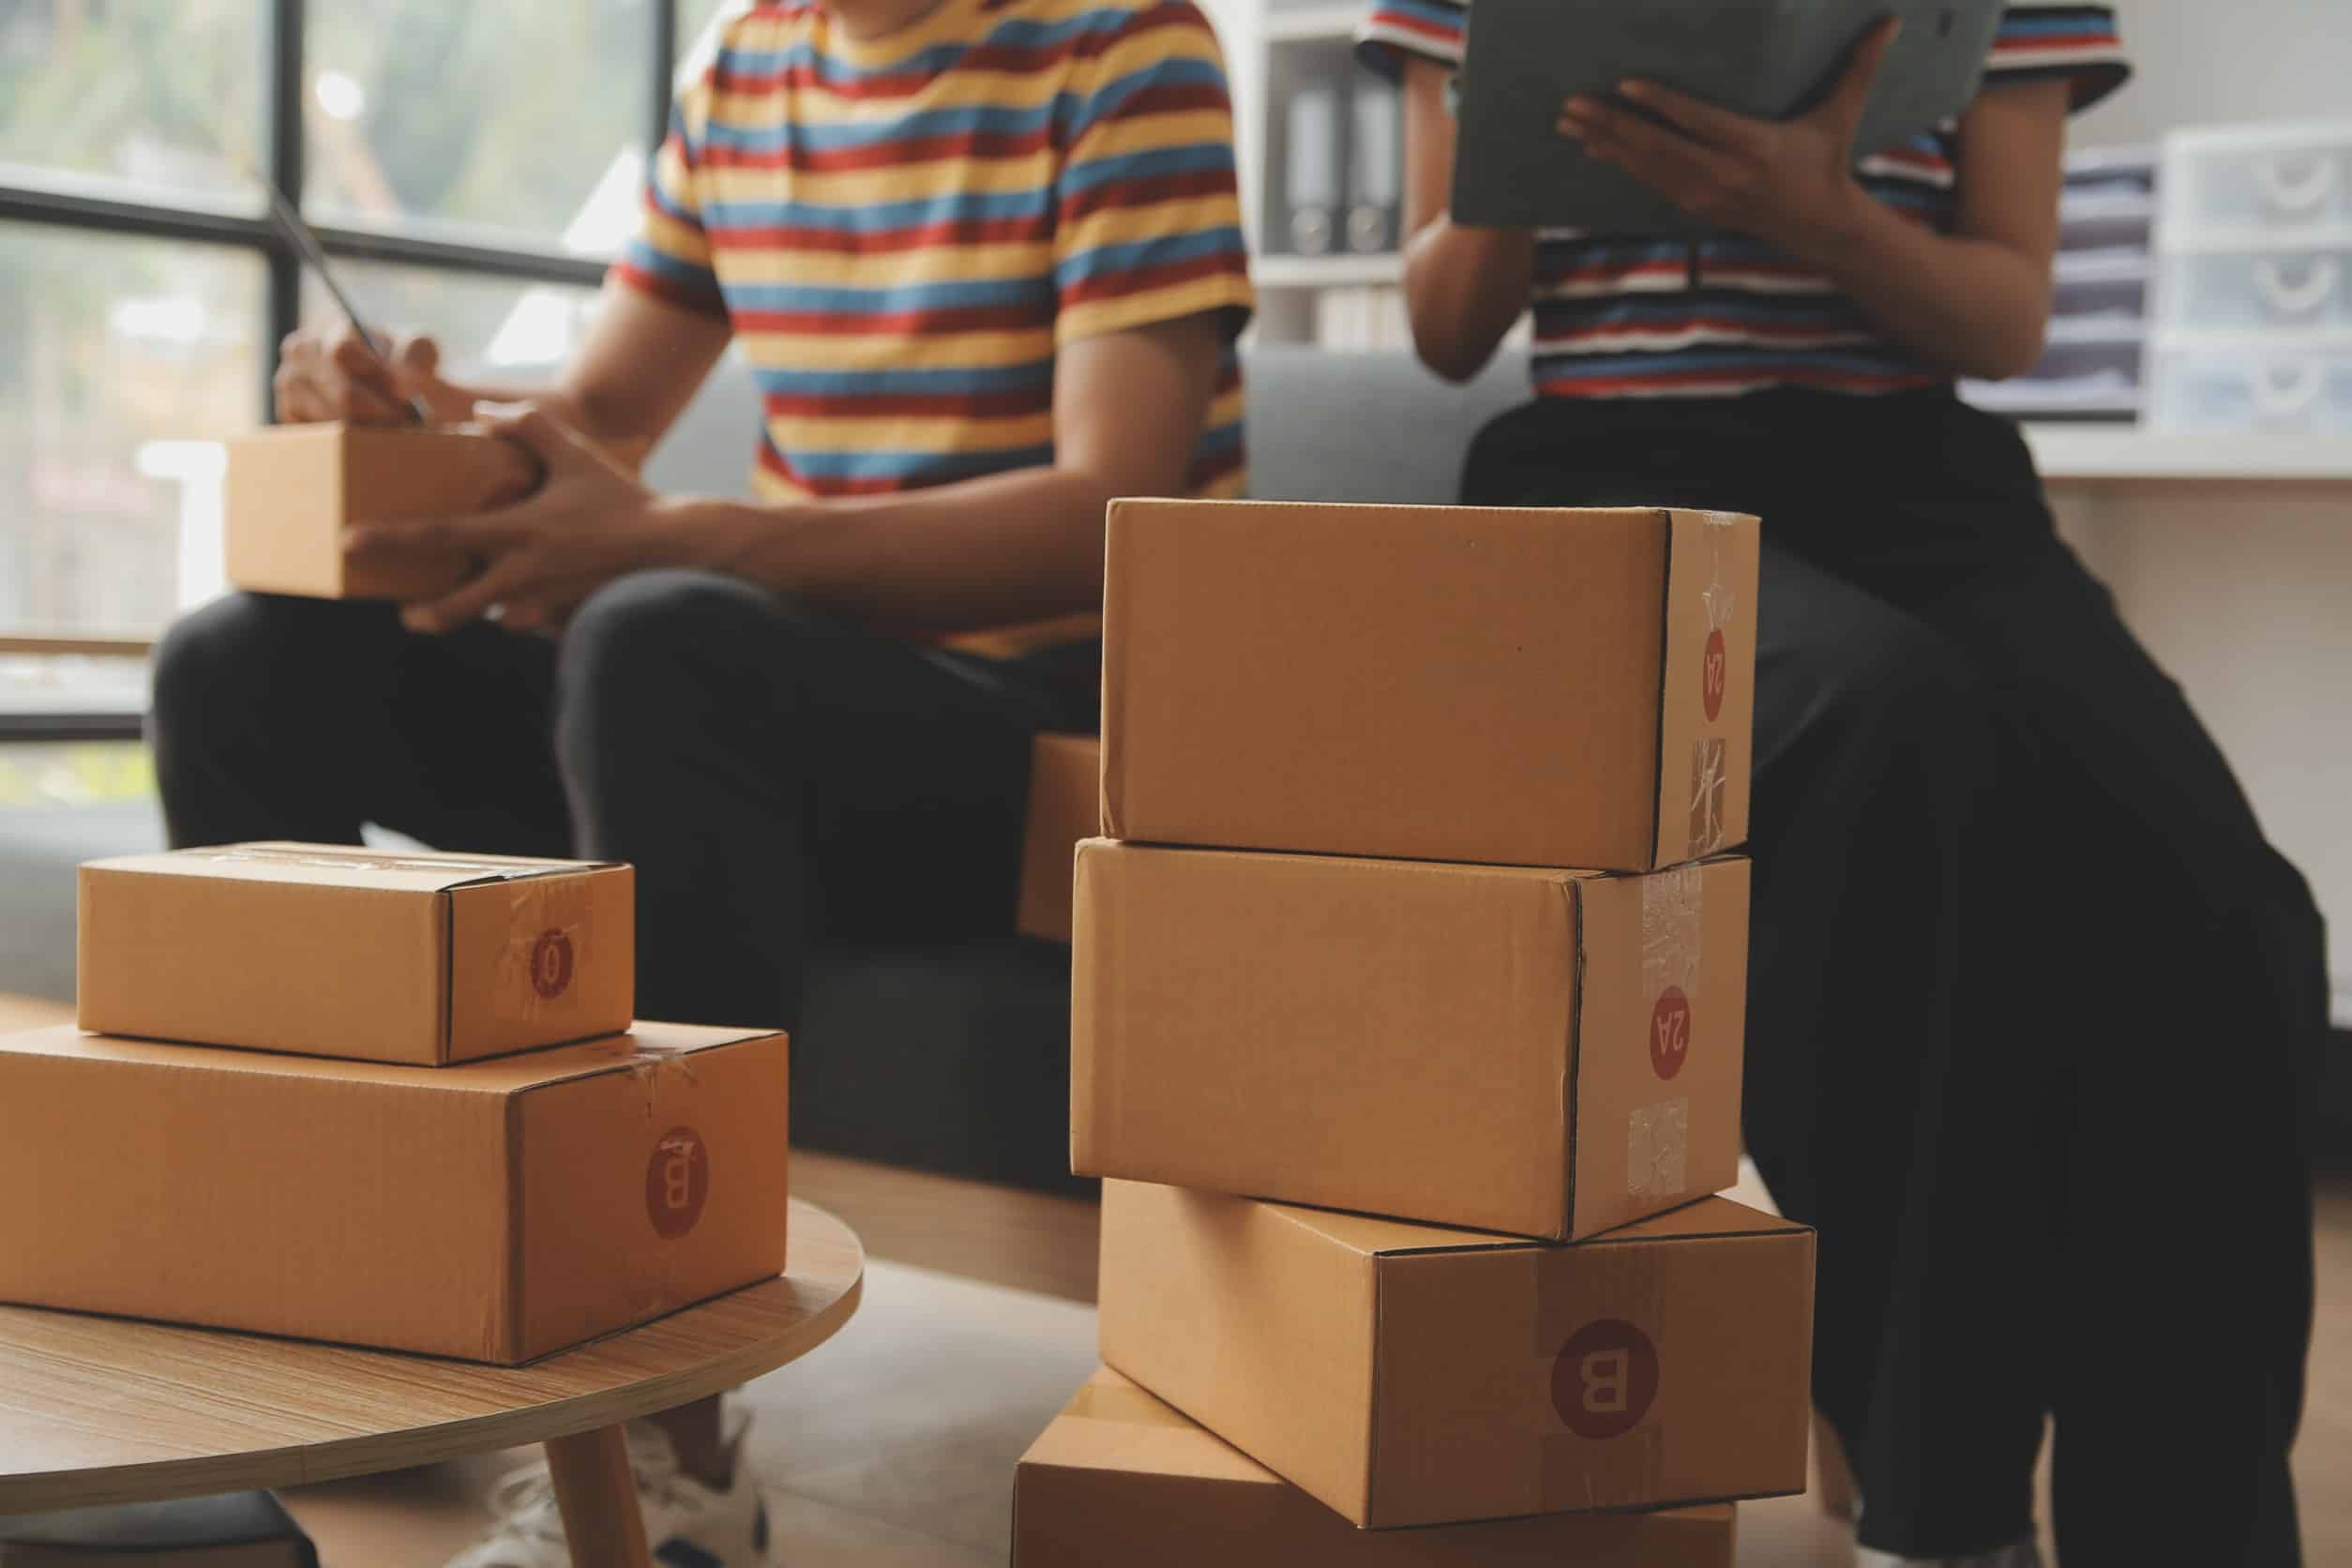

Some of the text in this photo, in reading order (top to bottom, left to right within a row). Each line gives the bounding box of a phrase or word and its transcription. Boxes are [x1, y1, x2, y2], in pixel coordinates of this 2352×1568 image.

[1707, 653, 1723, 695] 2A
[1657, 1010, 1685, 1056] 2A
[664, 1156, 690, 1209] B
[1581, 1348, 1629, 1412] B
